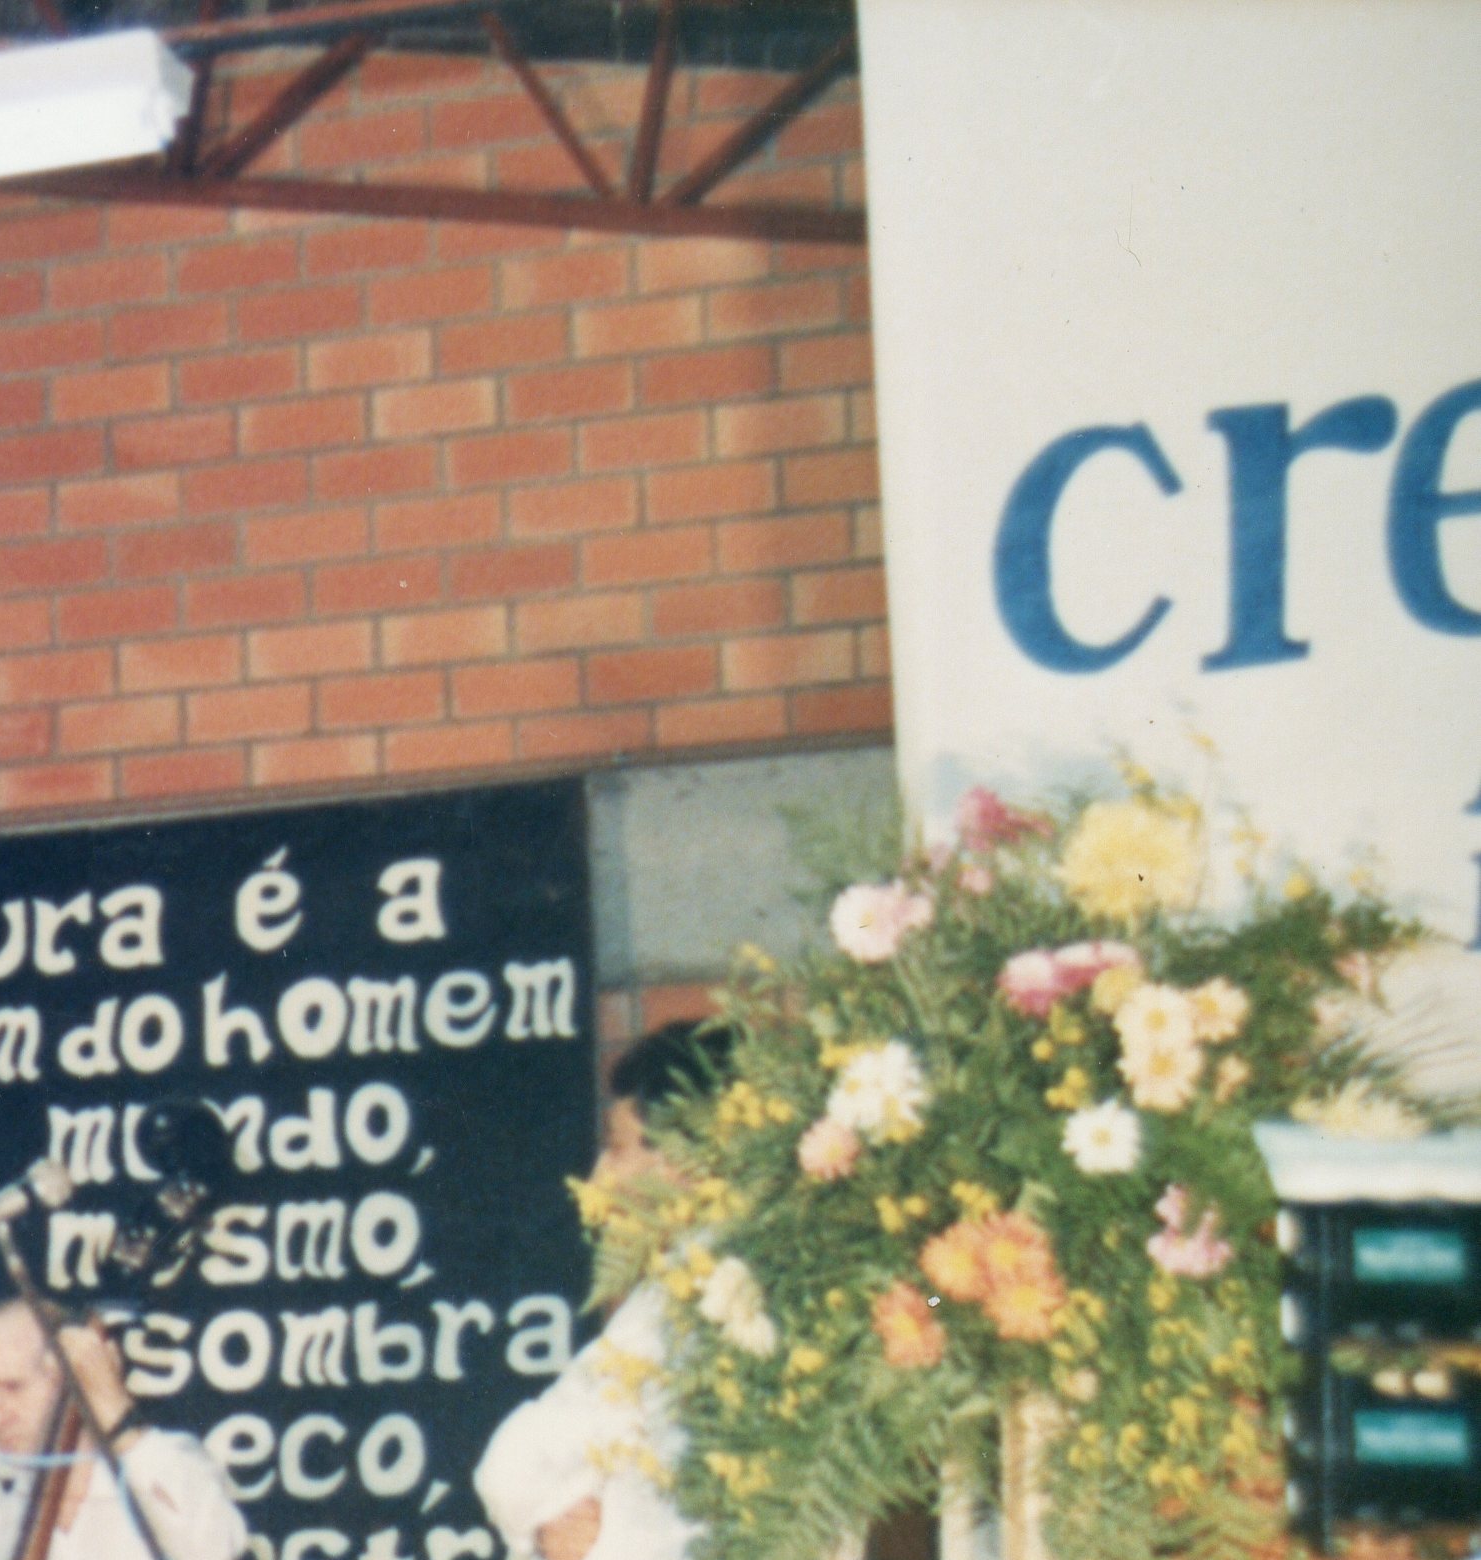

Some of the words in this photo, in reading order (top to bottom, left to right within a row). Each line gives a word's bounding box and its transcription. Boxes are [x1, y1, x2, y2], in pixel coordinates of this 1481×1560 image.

[235, 846, 303, 952] é
[376, 857, 446, 942] a
[47, 1191, 434, 1289] msmo,
[123, 1292, 574, 1395] sombra
